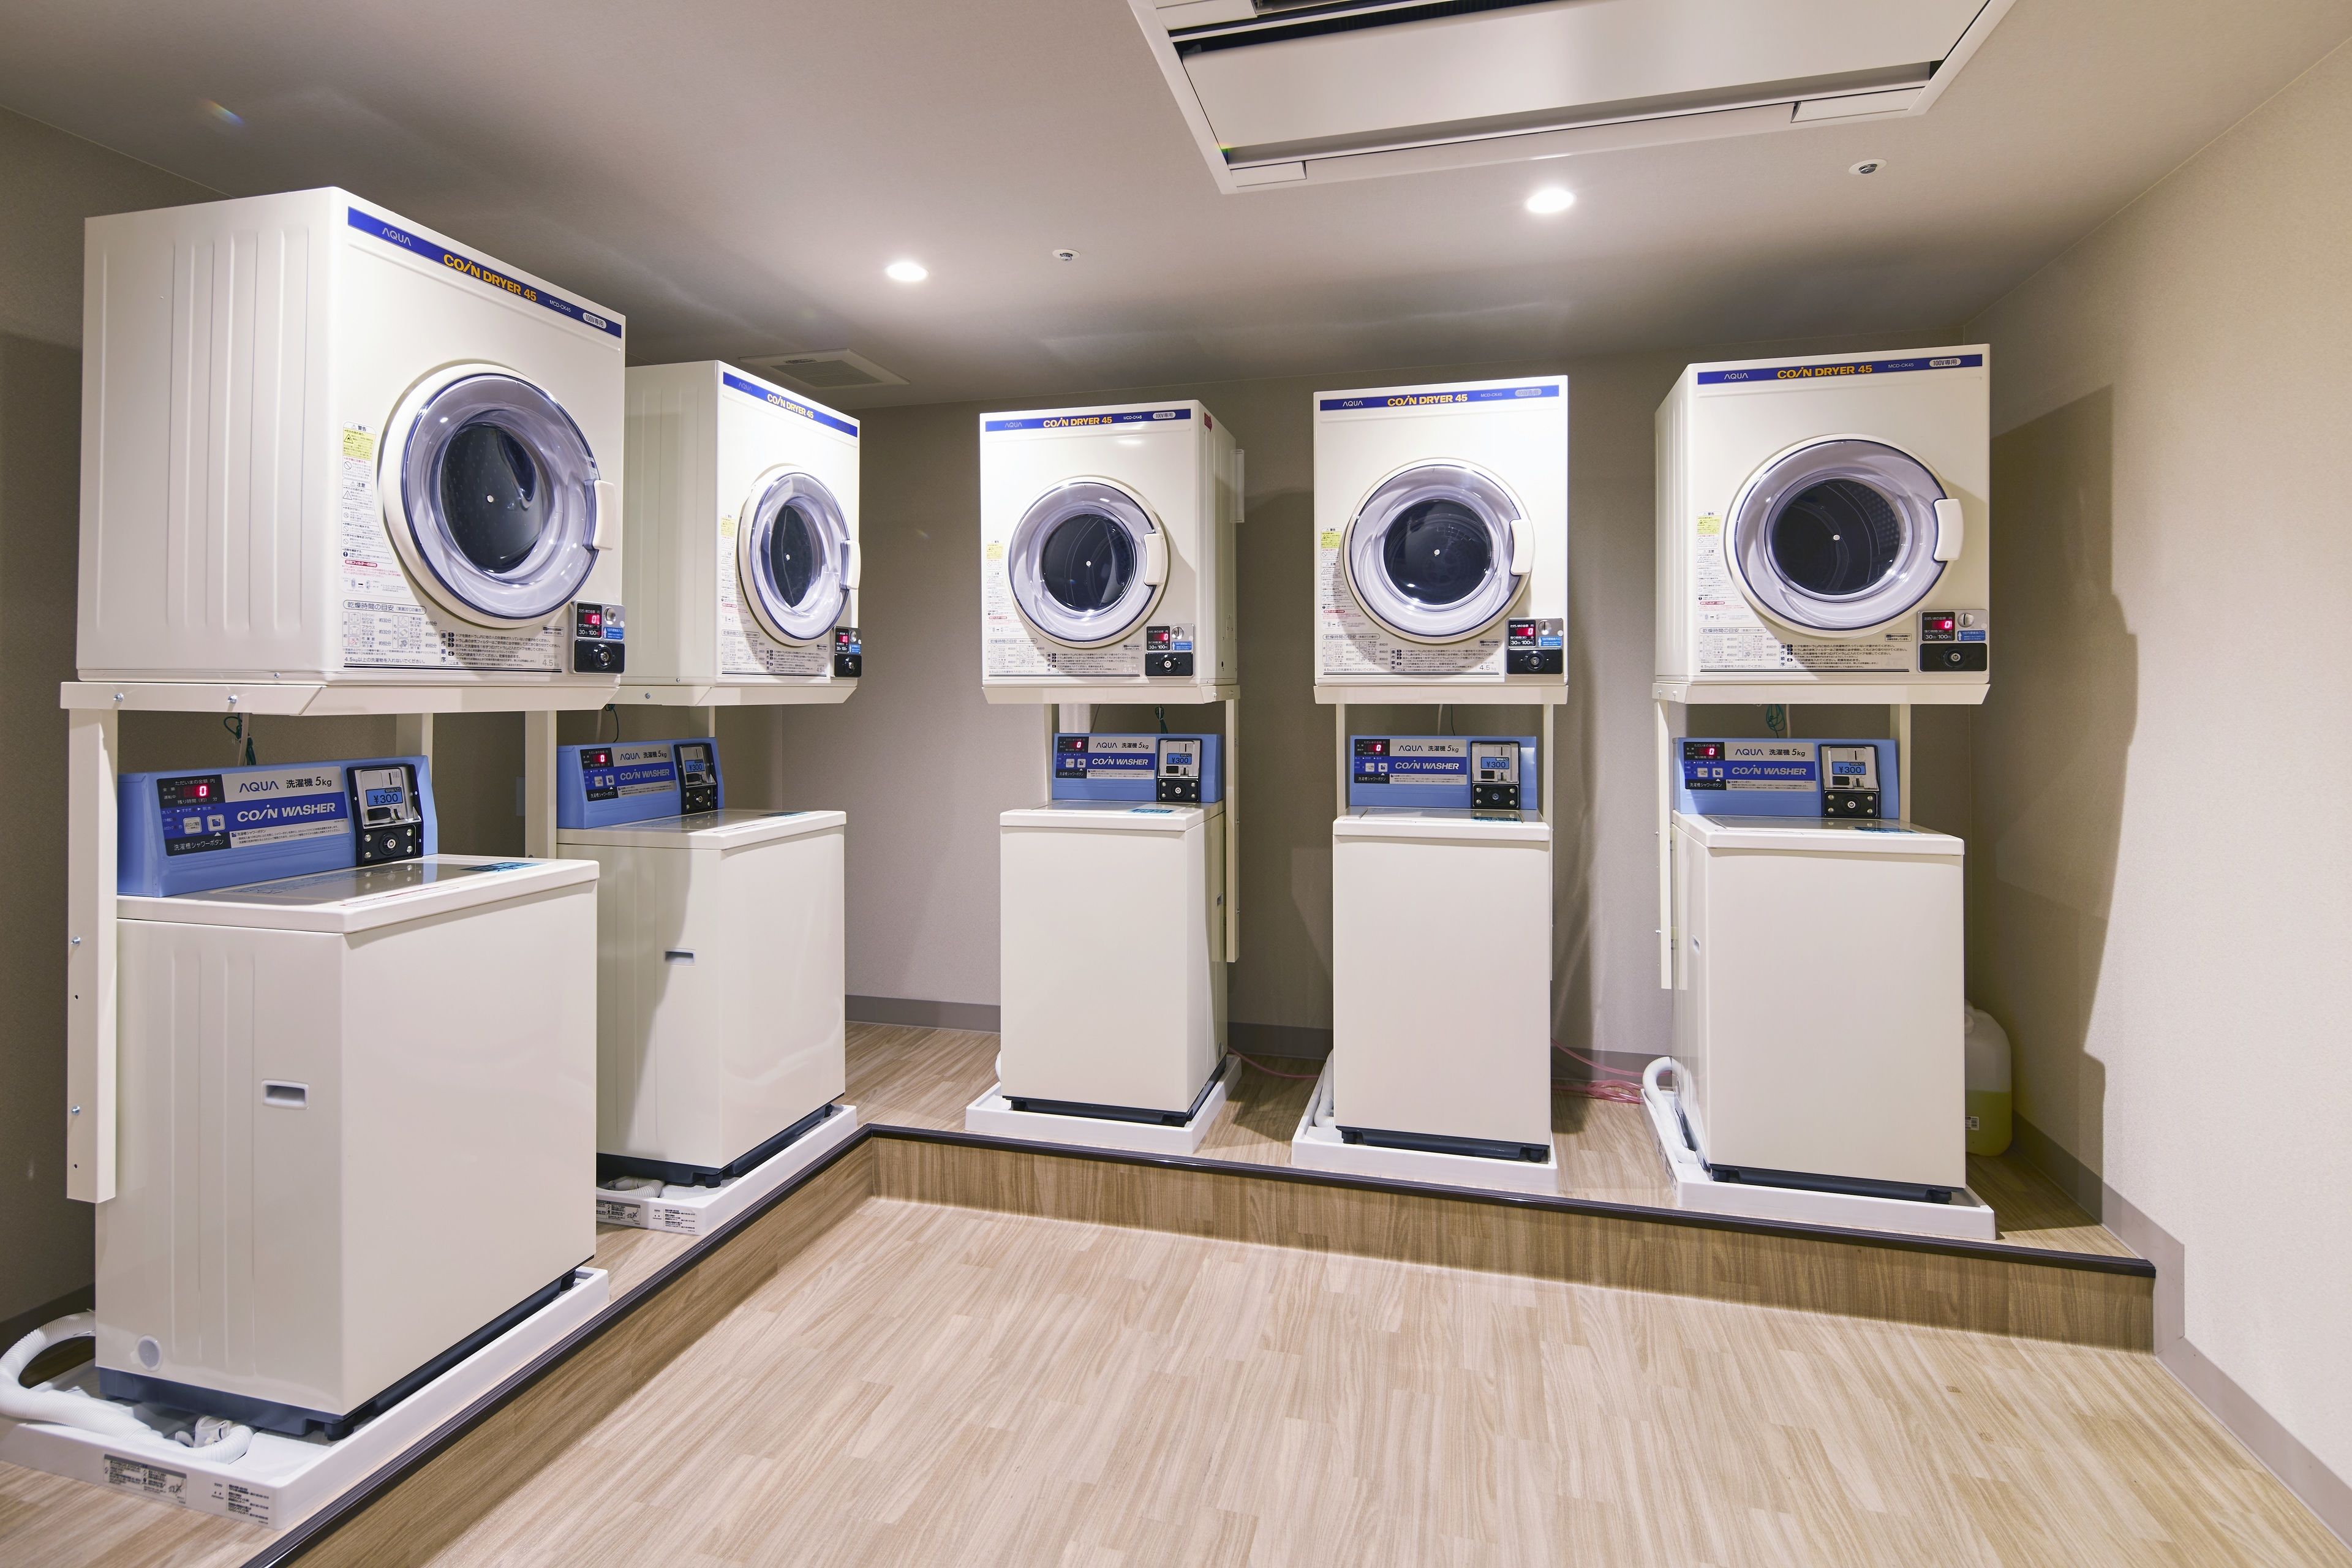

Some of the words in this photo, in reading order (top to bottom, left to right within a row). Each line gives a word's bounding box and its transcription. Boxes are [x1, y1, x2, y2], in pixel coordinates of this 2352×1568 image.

[382, 227, 412, 246] AQUA
[443, 254, 480, 279] COIN
[483, 270, 522, 294] DRYER
[523, 287, 537, 302] 45
[549, 300, 571, 312] MCD-CK45
[585, 314, 604, 328] 100V専用
[1777, 366, 1812, 379] COIN
[1815, 367, 1856, 377] DRYER
[1858, 365, 1872, 374] 45
[738, 382, 753, 392] AQUA
[767, 393, 786, 407] COIN
[786, 401, 806, 416] DRYER
[806, 410, 814, 419] 45
[1387, 395, 1417, 407] COIN
[1419, 395, 1453, 405] DRYER
[1043, 417, 1069, 428] COIN
[1071, 417, 1100, 426] DRYER
[347, 601, 394, 611] 乾燥時間の目安
[620, 752, 640, 761] AQUA
[1792, 748, 1806, 757] 5kg
[1092, 756, 1114, 765] COIN
[1395, 760, 1421, 769] COIN
[620, 769, 641, 780] COIN
[642, 769, 669, 777] WASHER
[1732, 764, 1762, 775] COIN
[239, 781, 279, 793] AQUA
[285, 778, 314, 789] 洗濯機
[315, 776, 332, 788] 5kg
[199, 786, 207, 796] 0
[374, 793, 398, 804] ¥300
[237, 804, 279, 822] COIN
[282, 802, 336, 818] WASHER
[174, 839, 224, 851] 洗濯槽シャワーボタン
